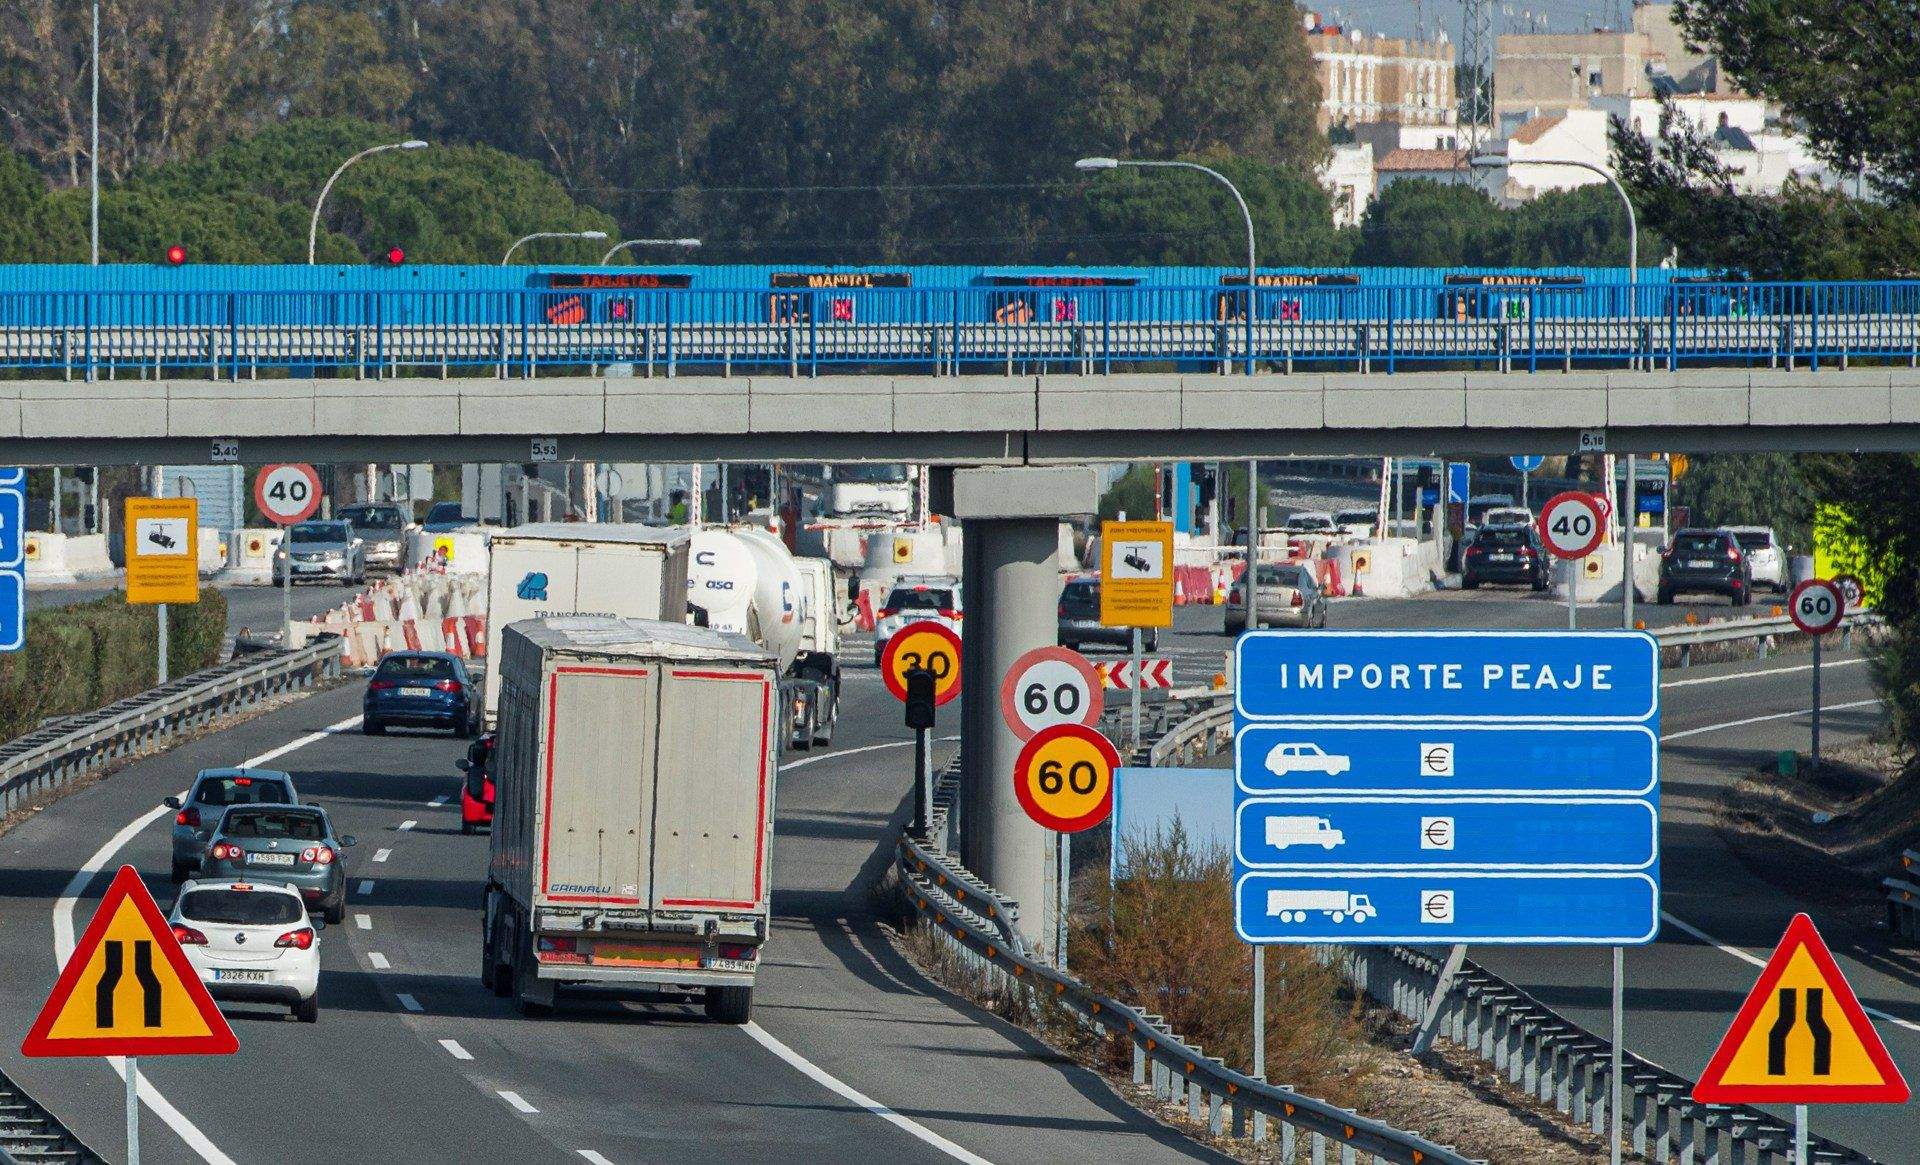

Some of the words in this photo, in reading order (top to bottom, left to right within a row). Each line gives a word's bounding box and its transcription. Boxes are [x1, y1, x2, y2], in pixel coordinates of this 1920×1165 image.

[532, 443, 557, 455] 5.53
[269, 480, 307, 502] 40
[1551, 514, 1592, 537] 40
[1801, 596, 1832, 616] 60
[901, 650, 951, 679] 30
[1280, 663, 1463, 690] IMPORTE
[1483, 664, 1613, 690] PEAJE
[1023, 682, 1080, 715] 60
[1038, 760, 1098, 795] 60
